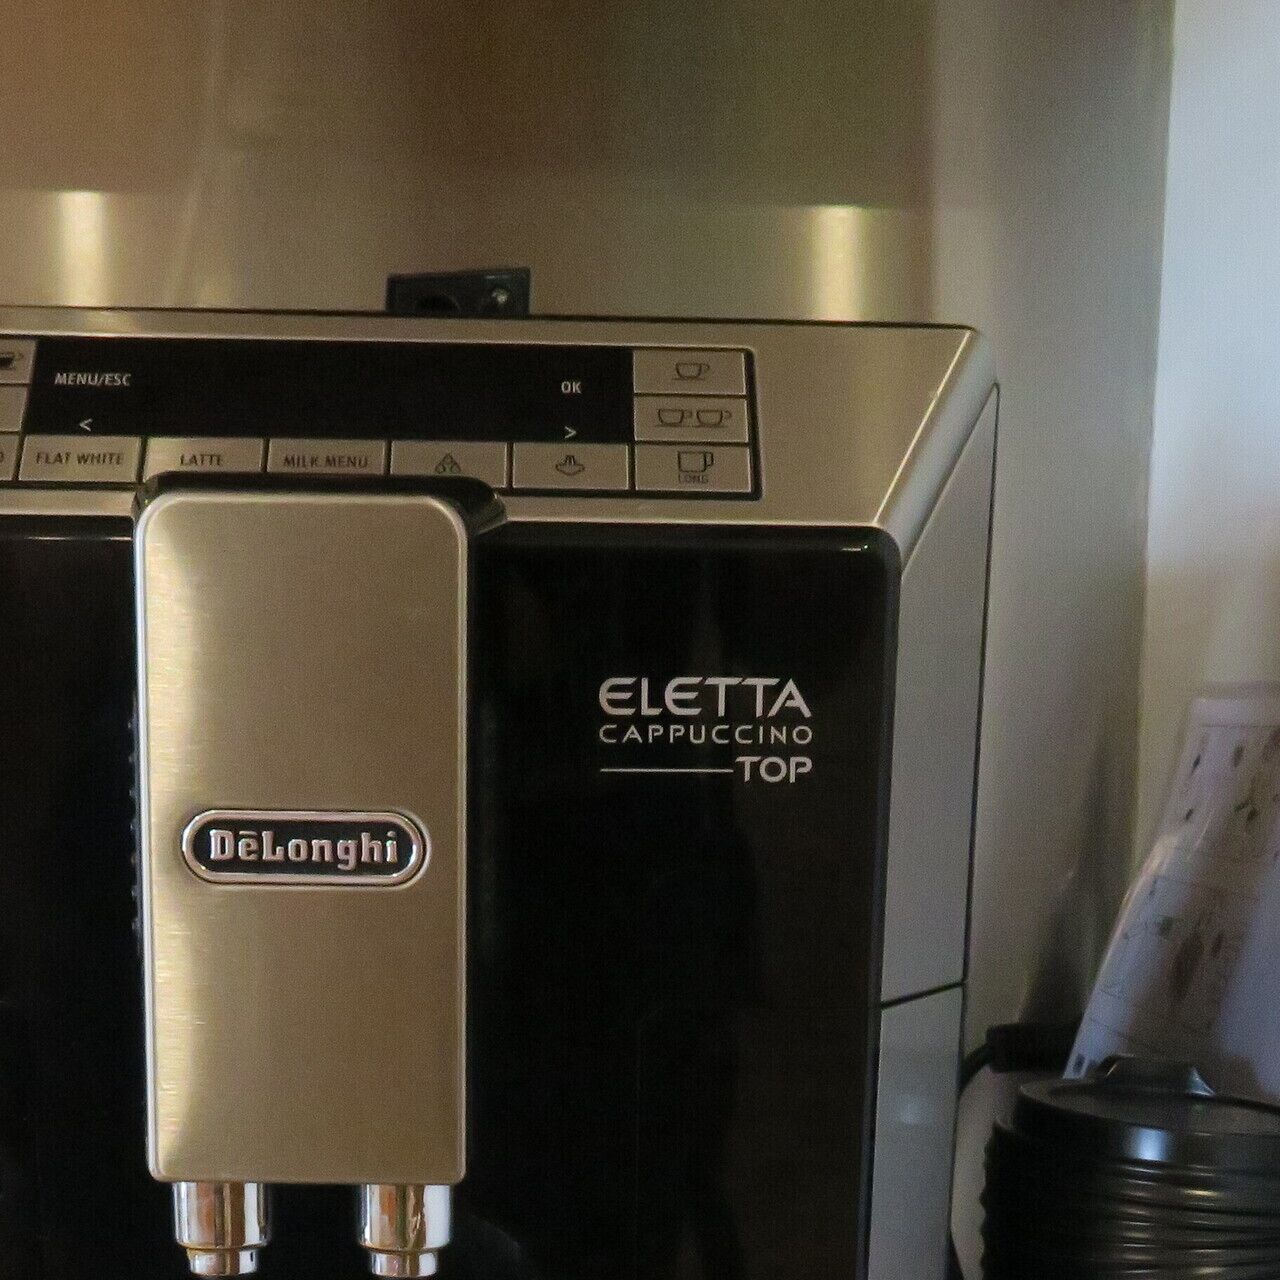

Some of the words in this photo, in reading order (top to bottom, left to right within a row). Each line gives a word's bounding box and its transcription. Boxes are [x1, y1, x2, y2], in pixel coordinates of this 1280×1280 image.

[54, 371, 132, 387] MENU/ESC
[560, 380, 583, 395] OK
[35, 451, 72, 466] FLAT
[76, 452, 125, 467] WHITE
[179, 453, 224, 467] LATTE
[283, 454, 320, 469] MILK
[324, 454, 369, 469] MENU
[598, 676, 813, 719] ELETTA
[598, 724, 814, 745] CAPPUCCINO
[734, 755, 814, 784] TOP
